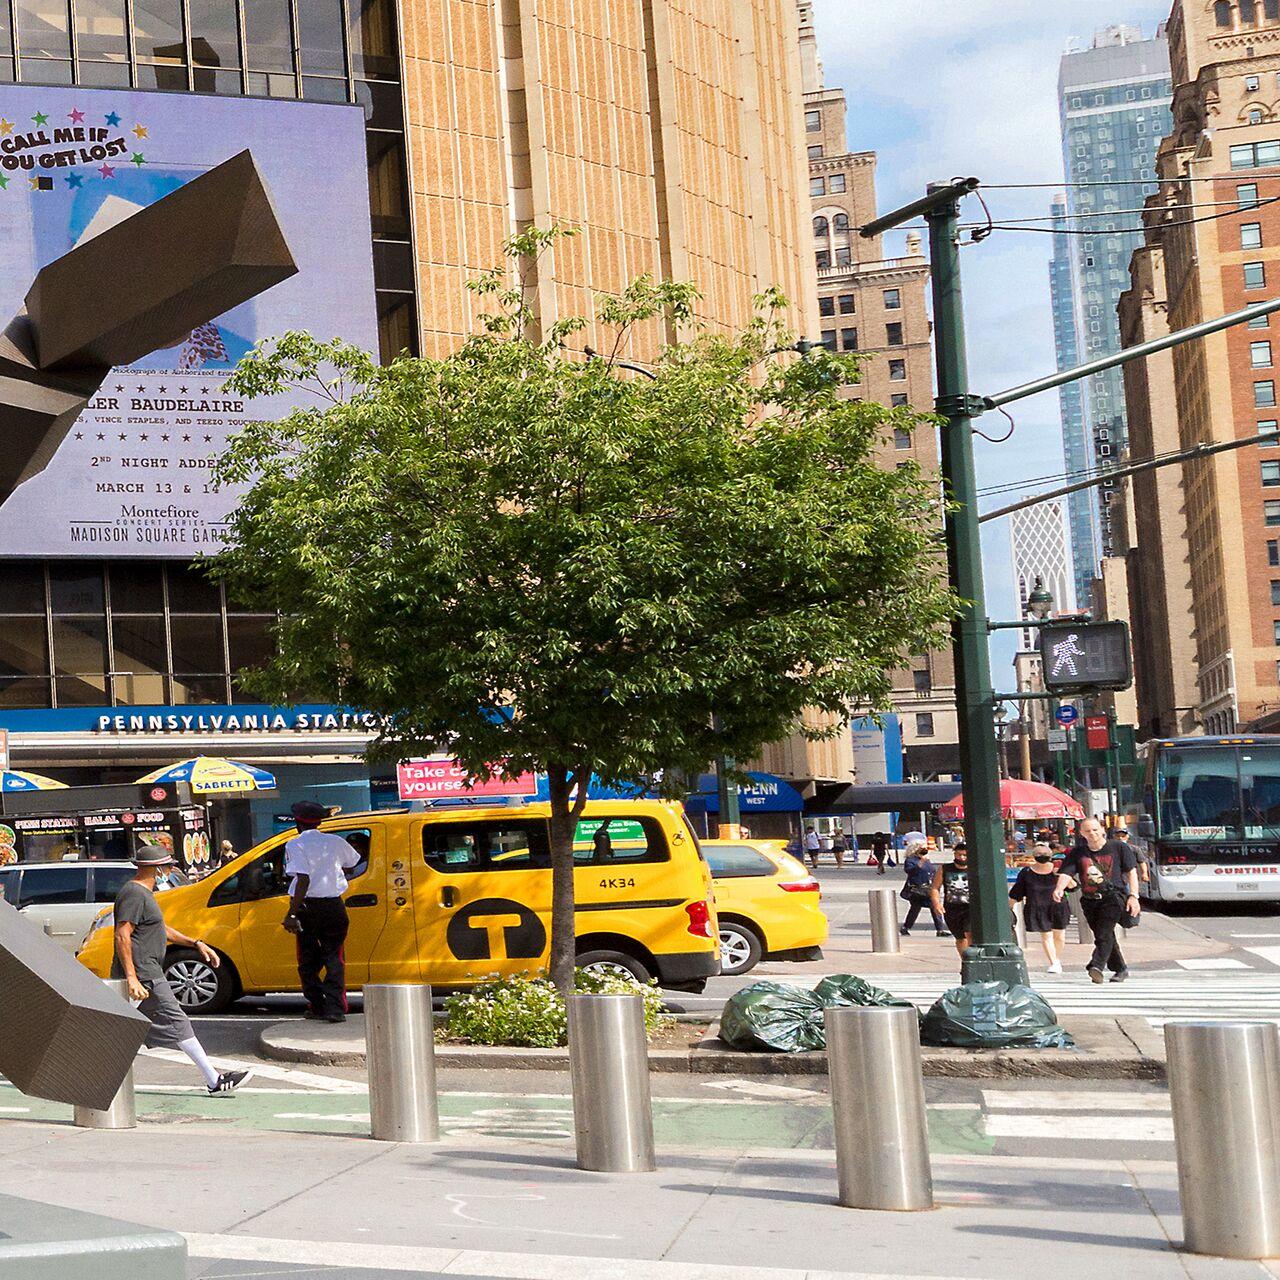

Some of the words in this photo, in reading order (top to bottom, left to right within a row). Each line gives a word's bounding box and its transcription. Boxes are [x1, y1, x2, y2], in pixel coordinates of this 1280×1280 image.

[1, 131, 51, 154] CALL
[54, 128, 85, 144] ME
[89, 127, 109, 143] IF
[39, 150, 77, 169] GET
[79, 137, 128, 163] LOST
[86, 398, 119, 410] LER
[131, 398, 244, 413] BAUDELAIRE
[95, 416, 122, 424] VINCE
[127, 417, 169, 425] STAPLES,
[121, 458, 169, 468] NIGHT
[96, 483, 145, 493] MARCH
[155, 483, 172, 493] 13
[183, 485, 191, 493] &
[202, 484, 220, 494] 14
[120, 504, 199, 518] Montefiore
[70, 527, 129, 542] MADISON
[136, 527, 186, 543] SQUARE
[99, 714, 287, 730] PENNSYLVANIA
[403, 766, 445, 779] Take
[449, 768, 468, 778] ca
[195, 779, 250, 790] SABRETT
[404, 780, 464, 795] yourse
[746, 797, 766, 805] WEST
[84, 815, 120, 826] HALAL
[136, 812, 164, 823] FOOD
[1214, 867, 1278, 875] GUNTHER
[599, 878, 635, 888] 4K34
[468, 913, 522, 960] T
